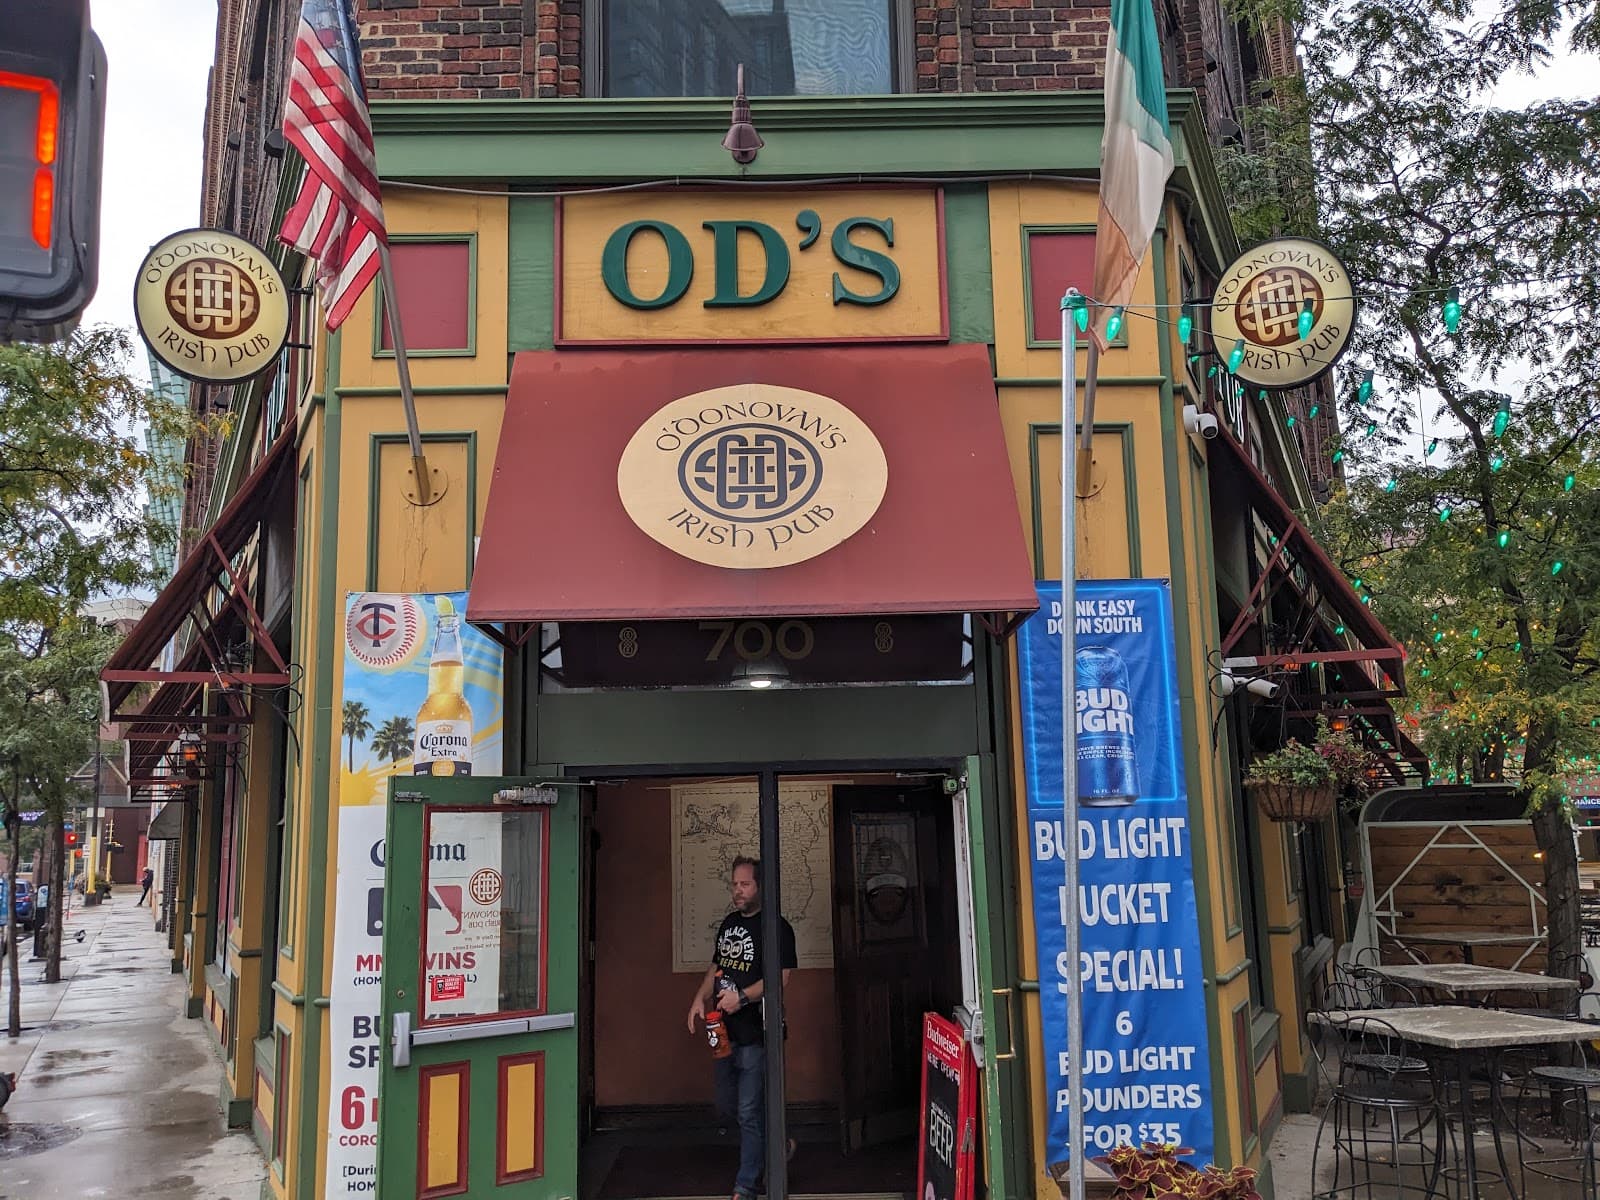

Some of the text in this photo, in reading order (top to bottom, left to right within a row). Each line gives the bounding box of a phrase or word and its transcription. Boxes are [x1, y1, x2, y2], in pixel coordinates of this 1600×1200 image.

[601, 208, 901, 312] OD'S
[1241, 348, 1291, 370] RISH
[655, 401, 848, 452] O'DONOVAN'S
[1051, 600, 1135, 617] DNK EASY
[1047, 617, 1143, 635] DN SOUTH
[700, 620, 815, 662] 700
[1076, 687, 1128, 711] BUD
[1076, 709, 1134, 735] IGHT
[420, 733, 468, 750] Corona
[431, 747, 458, 756] Extra
[1101, 817, 1185, 859] LIGHT
[725, 925, 755, 961] BLACK KEYS
[1115, 1010, 1134, 1036] 6
[926, 1021, 960, 1059] Budweiser
[1119, 1046, 1196, 1073] LIGHT
[341, 1085, 366, 1130] 6
[929, 1108, 954, 1168] BEER
[1139, 1122, 1182, 1146] $35
